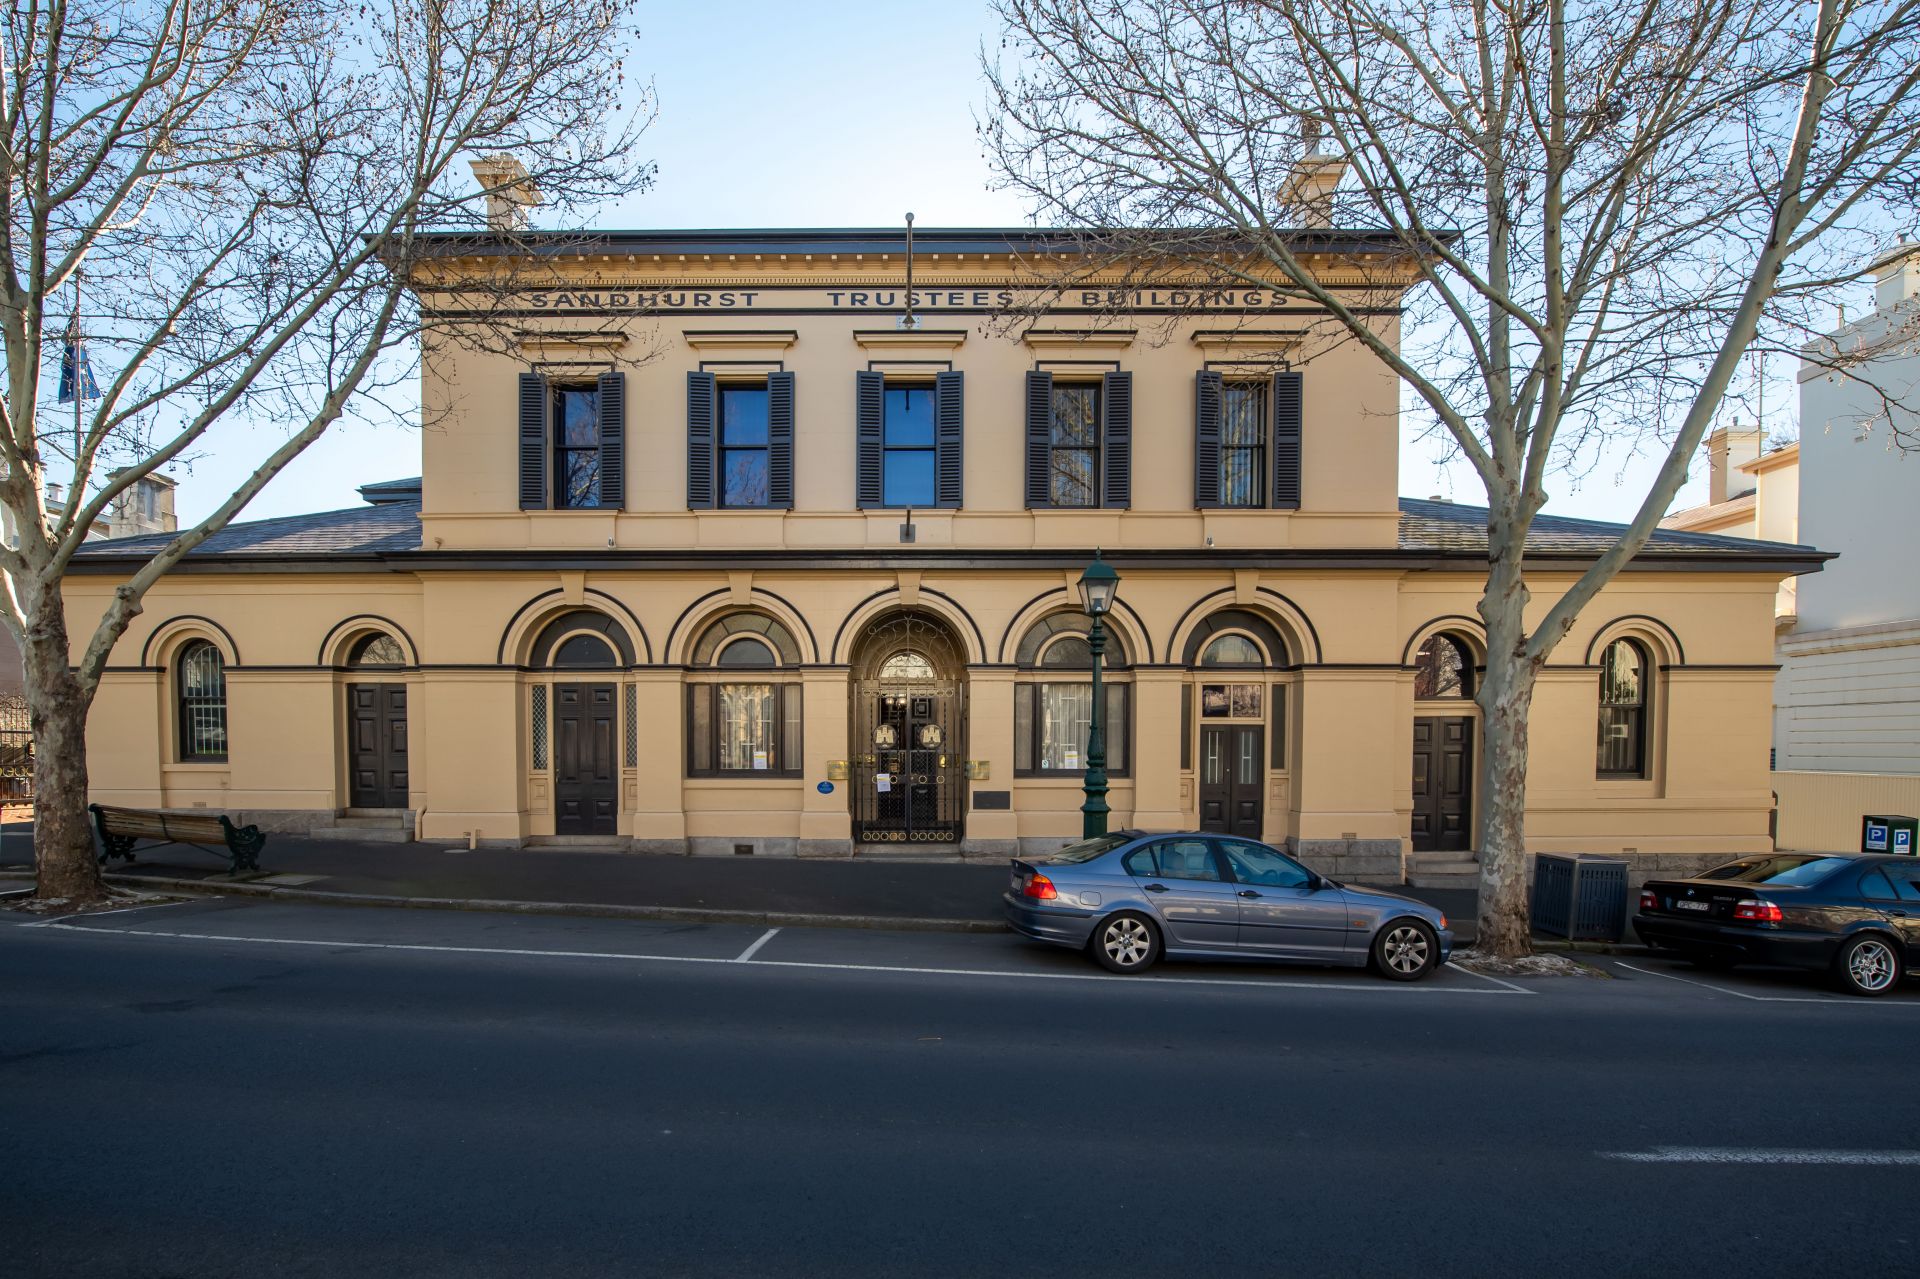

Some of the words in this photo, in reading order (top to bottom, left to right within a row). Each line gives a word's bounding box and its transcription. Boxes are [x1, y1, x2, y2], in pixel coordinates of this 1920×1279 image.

[531, 292, 759, 308] SANDHURST
[826, 291, 1014, 307] TRUSTEES
[1081, 291, 1288, 306] BUILDINGS
[1871, 829, 1882, 840] P
[1897, 833, 1907, 844] P
